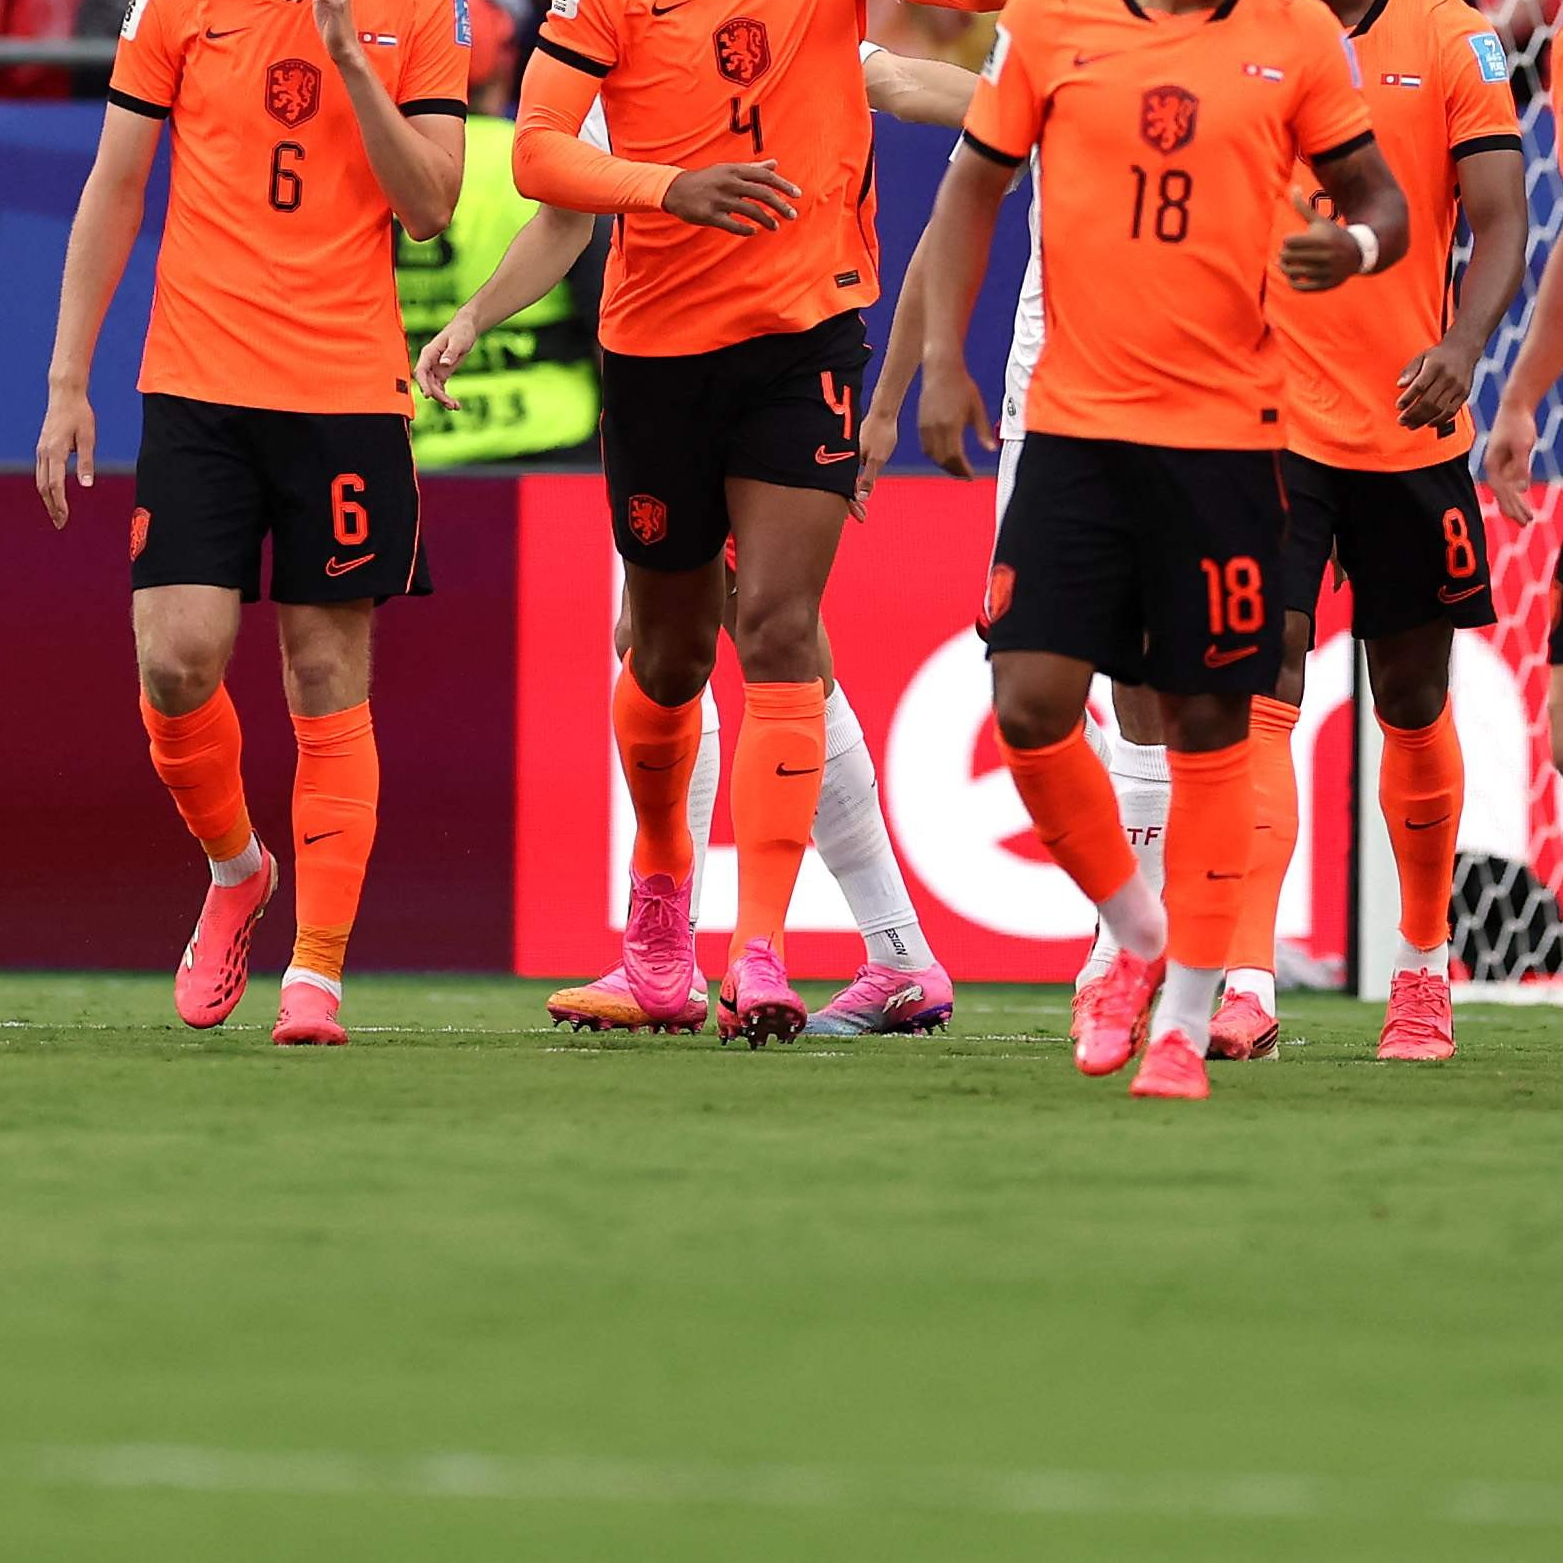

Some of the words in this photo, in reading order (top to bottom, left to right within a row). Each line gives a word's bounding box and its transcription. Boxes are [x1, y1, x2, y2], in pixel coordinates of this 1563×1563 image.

[729, 96, 764, 155] 4
[268, 140, 305, 214] 6
[1130, 164, 1194, 244] 18
[819, 370, 853, 441] 4
[330, 472, 370, 547] 6
[1441, 506, 1478, 579] 8
[1200, 555, 1265, 635] 18
[1124, 825, 1164, 847] TF
